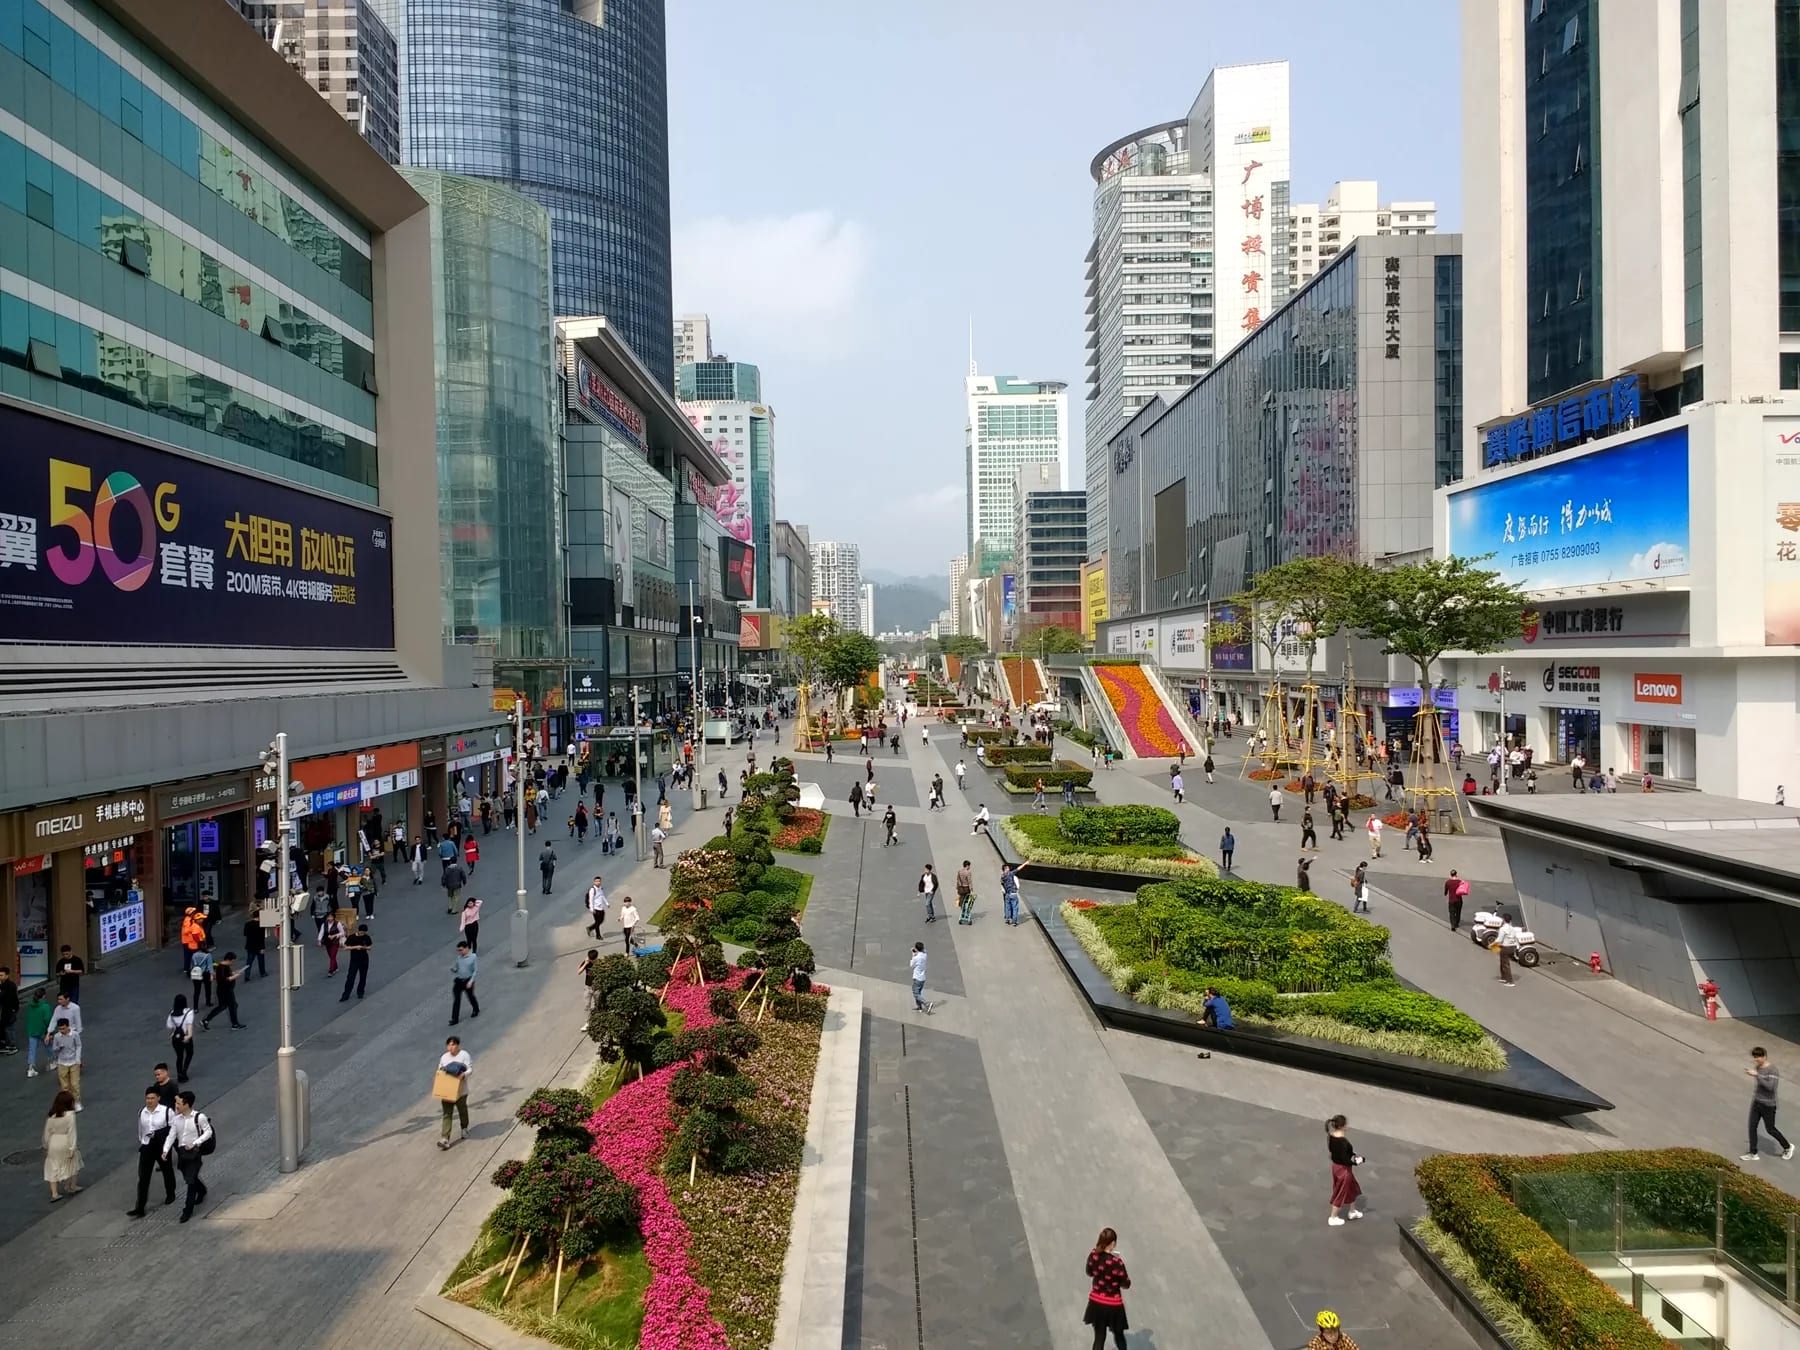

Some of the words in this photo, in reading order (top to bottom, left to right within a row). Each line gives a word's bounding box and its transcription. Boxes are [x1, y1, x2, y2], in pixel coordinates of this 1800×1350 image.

[224, 511, 294, 568] 大胆用
[300, 526, 356, 578] 放心玩
[1511, 551, 1540, 568] 广告招商
[1540, 547, 1559, 563] 0755
[1561, 541, 1601, 560] 82909093
[1776, 541, 1797, 561] 花
[159, 541, 215, 591] 套餐
[1542, 606, 1623, 634] 中国工商银行
[1558, 666, 1601, 680] SEGCOM
[1636, 680, 1678, 698] Lenovo
[95, 798, 145, 823] 手机维修中心
[35, 813, 83, 838] MEIZU
